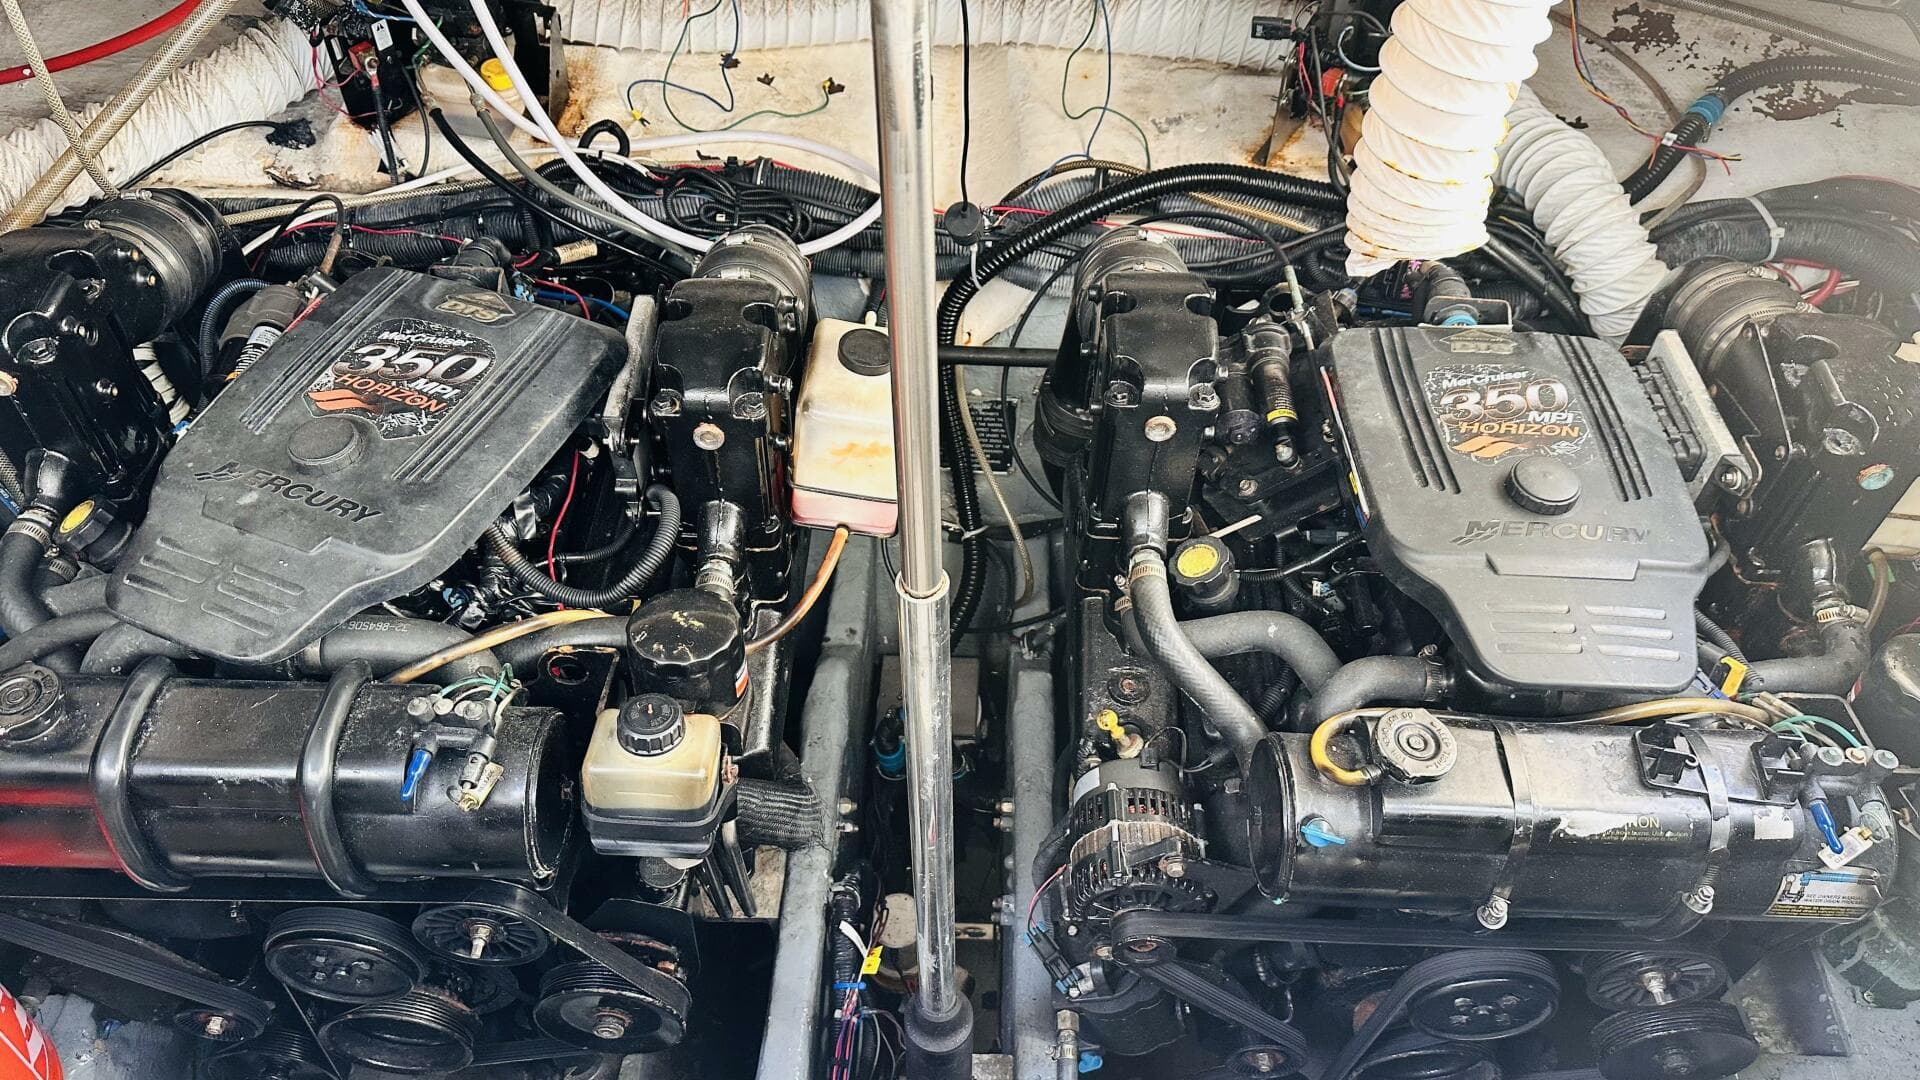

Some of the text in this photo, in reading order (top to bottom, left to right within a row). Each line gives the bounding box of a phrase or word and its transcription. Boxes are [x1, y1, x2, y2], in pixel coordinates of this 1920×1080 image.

[377, 330, 473, 347] MerCruiser
[332, 342, 494, 385] 350
[410, 378, 462, 400] MPI
[1442, 370, 1529, 389] MerCruiser
[335, 373, 448, 413] HORIZON
[1439, 378, 1569, 425] 350
[1459, 421, 1581, 438] HORIZON
[1528, 410, 1575, 424] MPI
[194, 460, 382, 523] MERCURY
[1450, 518, 1651, 546] MERCURY
